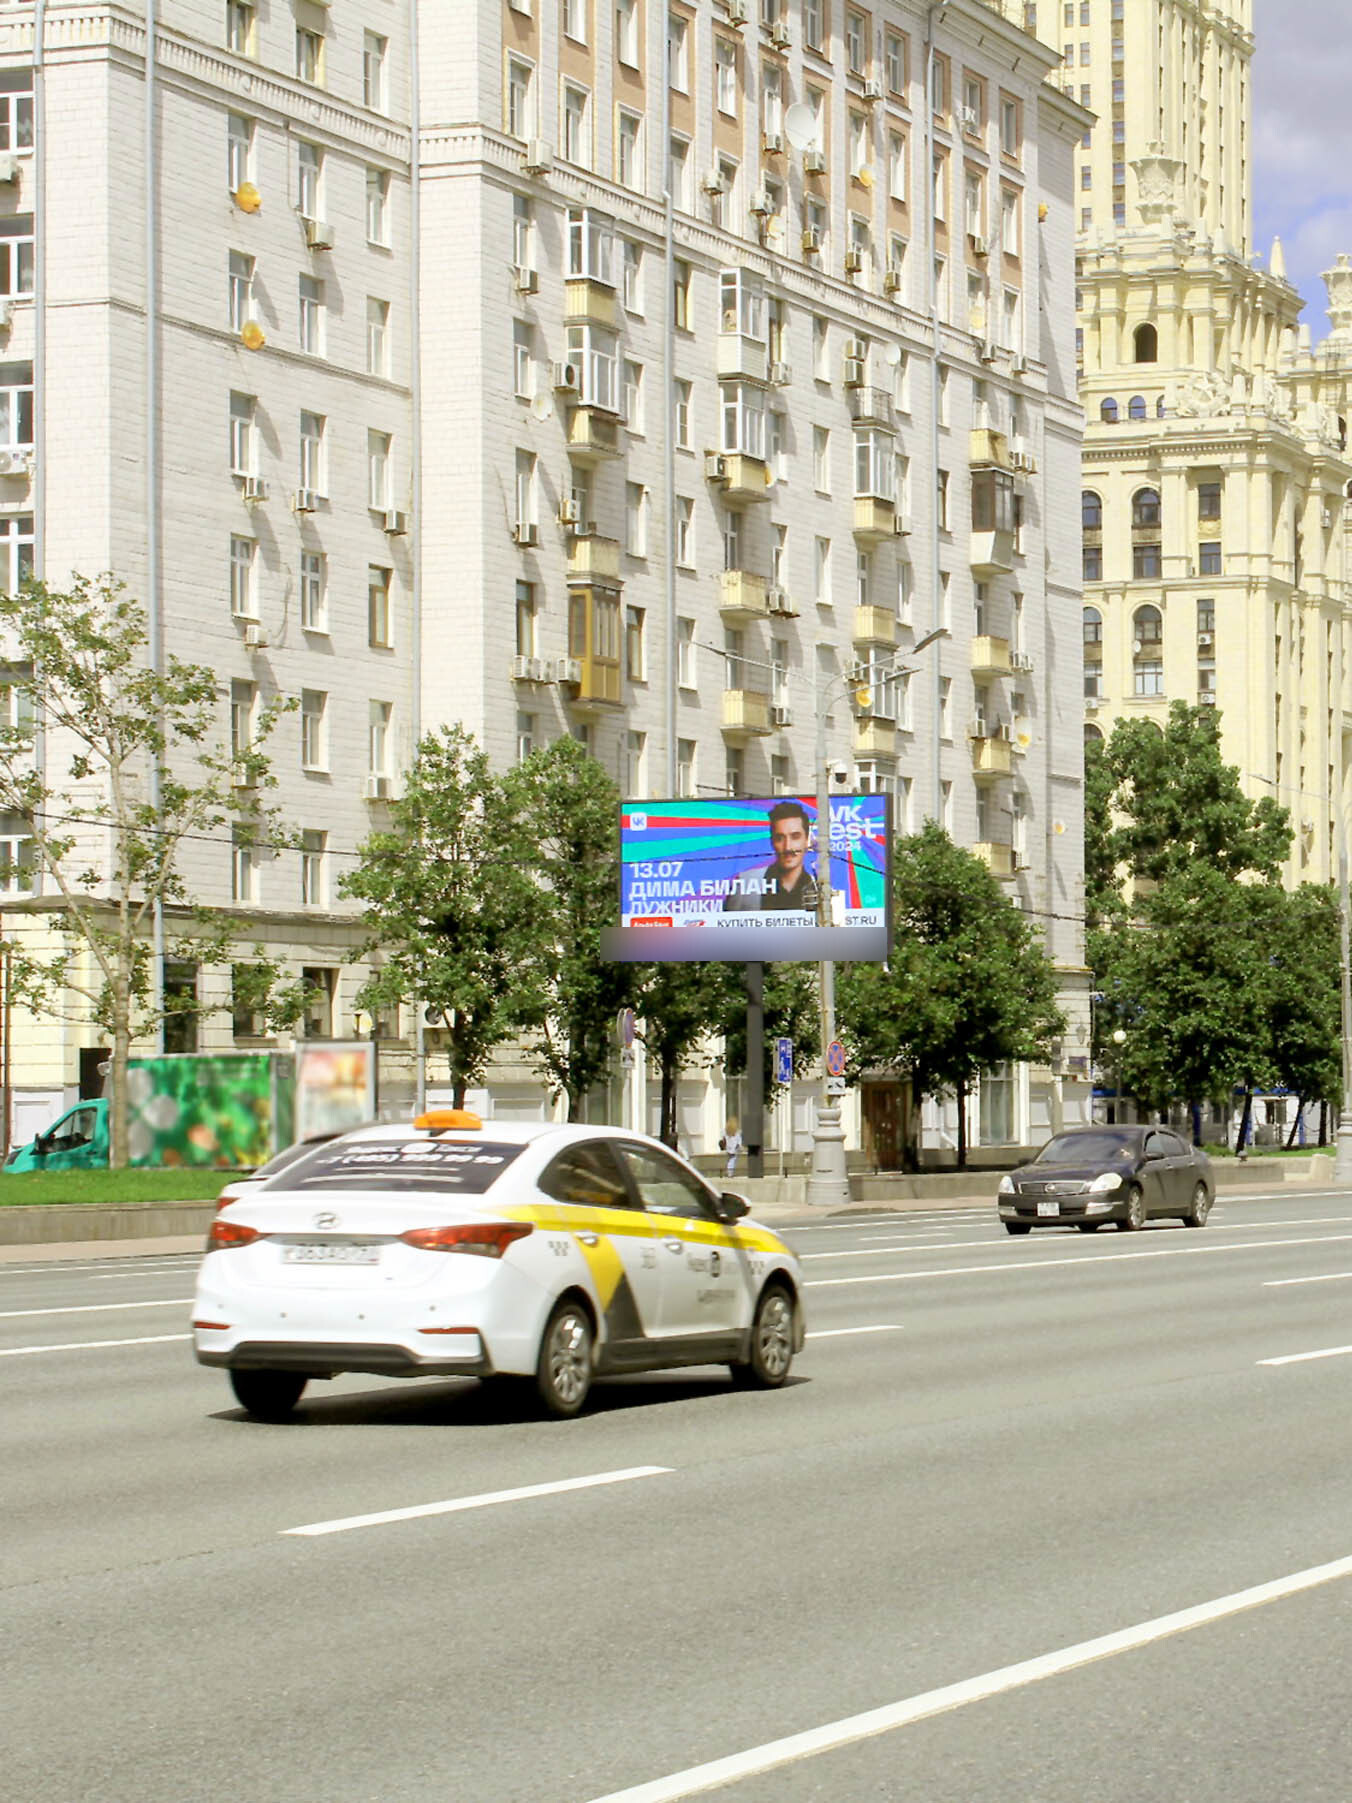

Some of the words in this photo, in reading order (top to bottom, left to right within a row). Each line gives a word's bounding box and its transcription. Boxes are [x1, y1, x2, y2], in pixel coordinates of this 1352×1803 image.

[829, 805, 863, 822] VK
[829, 841, 862, 852] 2024
[629, 862, 683, 878] 13.07
[629, 881, 696, 901] ДИМА
[700, 878, 777, 896] БИЛАН
[630, 899, 724, 914] ЛУЖНИКИ
[717, 919, 763, 927] КУПИТЬ
[765, 917, 813, 927] БИЛЕТЫ
